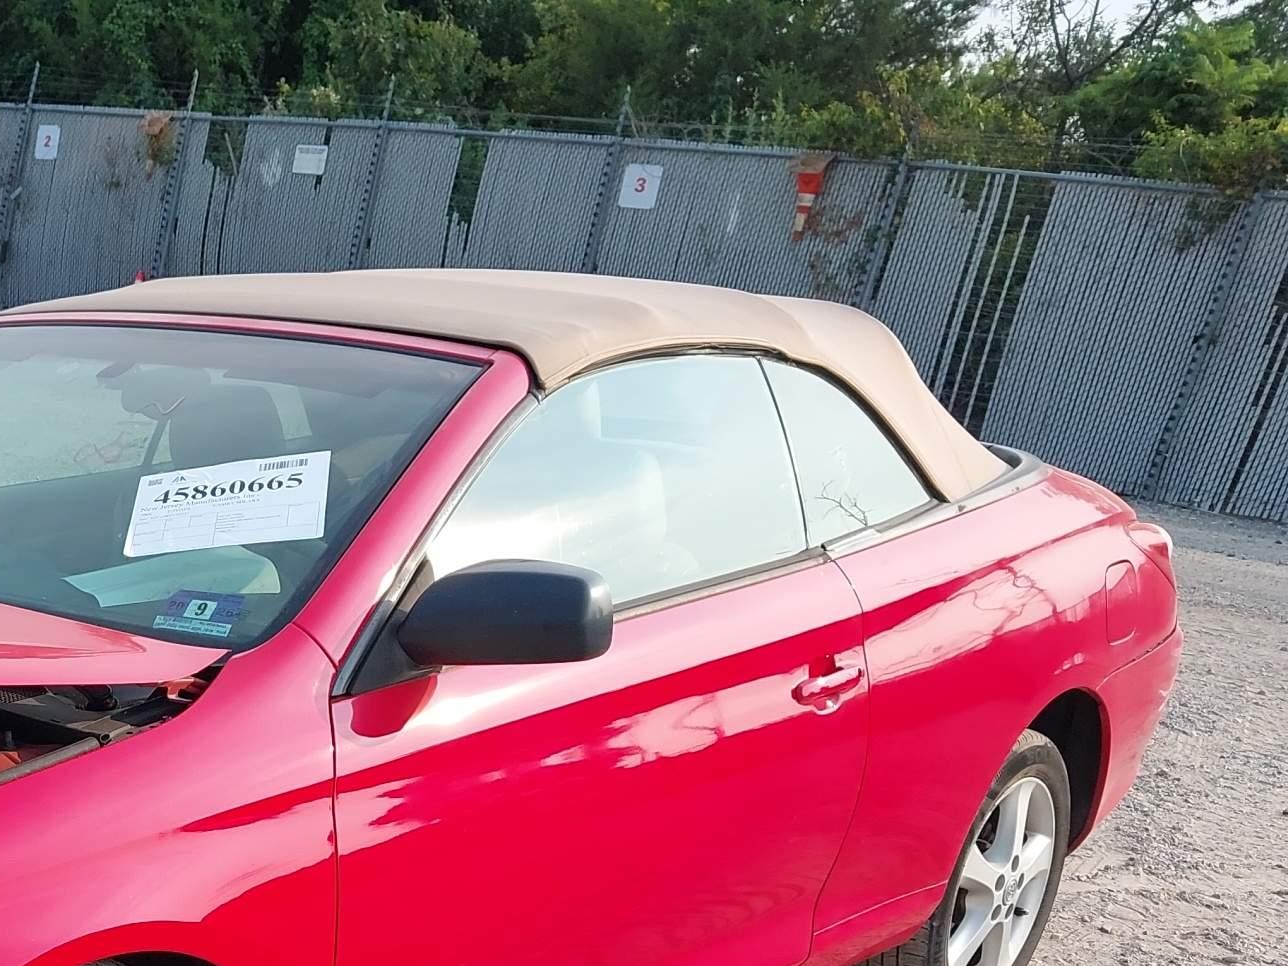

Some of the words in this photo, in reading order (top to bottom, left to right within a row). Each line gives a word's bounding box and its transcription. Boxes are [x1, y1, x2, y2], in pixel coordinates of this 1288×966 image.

[44, 135, 52, 147] 2
[634, 177, 647, 192] 3
[153, 473, 304, 504] 45860665
[194, 602, 208, 616] 9
